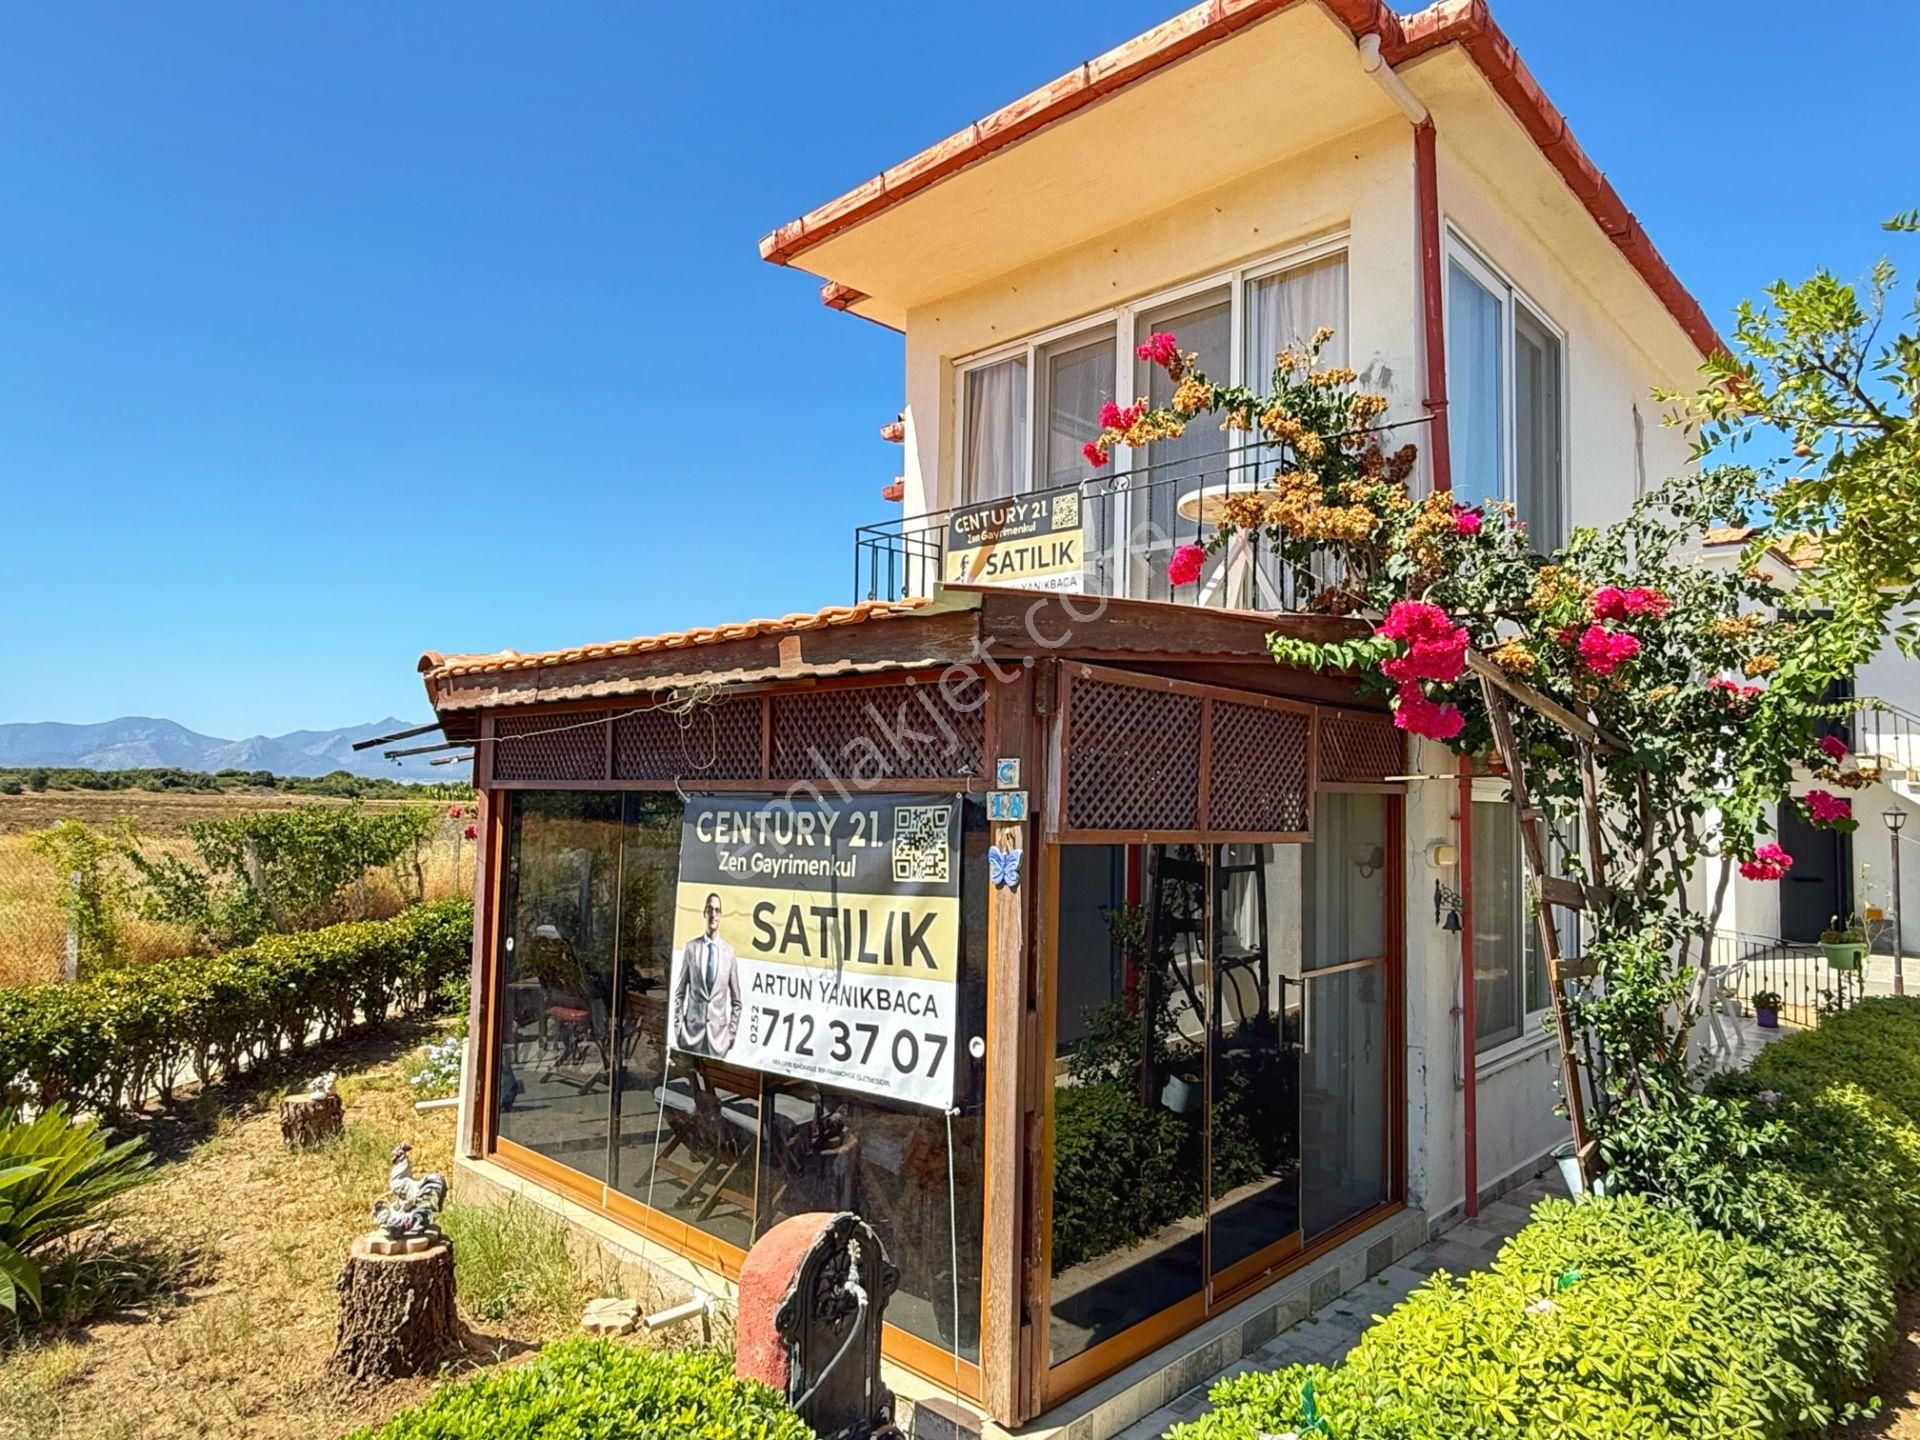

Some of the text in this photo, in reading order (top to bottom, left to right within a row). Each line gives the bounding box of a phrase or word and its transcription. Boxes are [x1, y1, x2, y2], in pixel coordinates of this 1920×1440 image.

[955, 503, 1028, 534] CENTURY
[981, 523, 1036, 541] Gayrimenkul
[986, 540, 1074, 576] SATILIK
[998, 762, 1013, 784] C
[992, 794, 1024, 819] 18
[696, 810, 842, 848] CENTURY
[718, 853, 857, 879] Zen Gayrimenkul
[751, 901, 939, 970] SATILIK
[751, 972, 939, 1018] ARTUN YANIKBACA
[750, 1005, 760, 1044] 0252
[761, 1008, 816, 1057] 712
[829, 1020, 880, 1065] 37
[891, 1029, 949, 1078] 07
